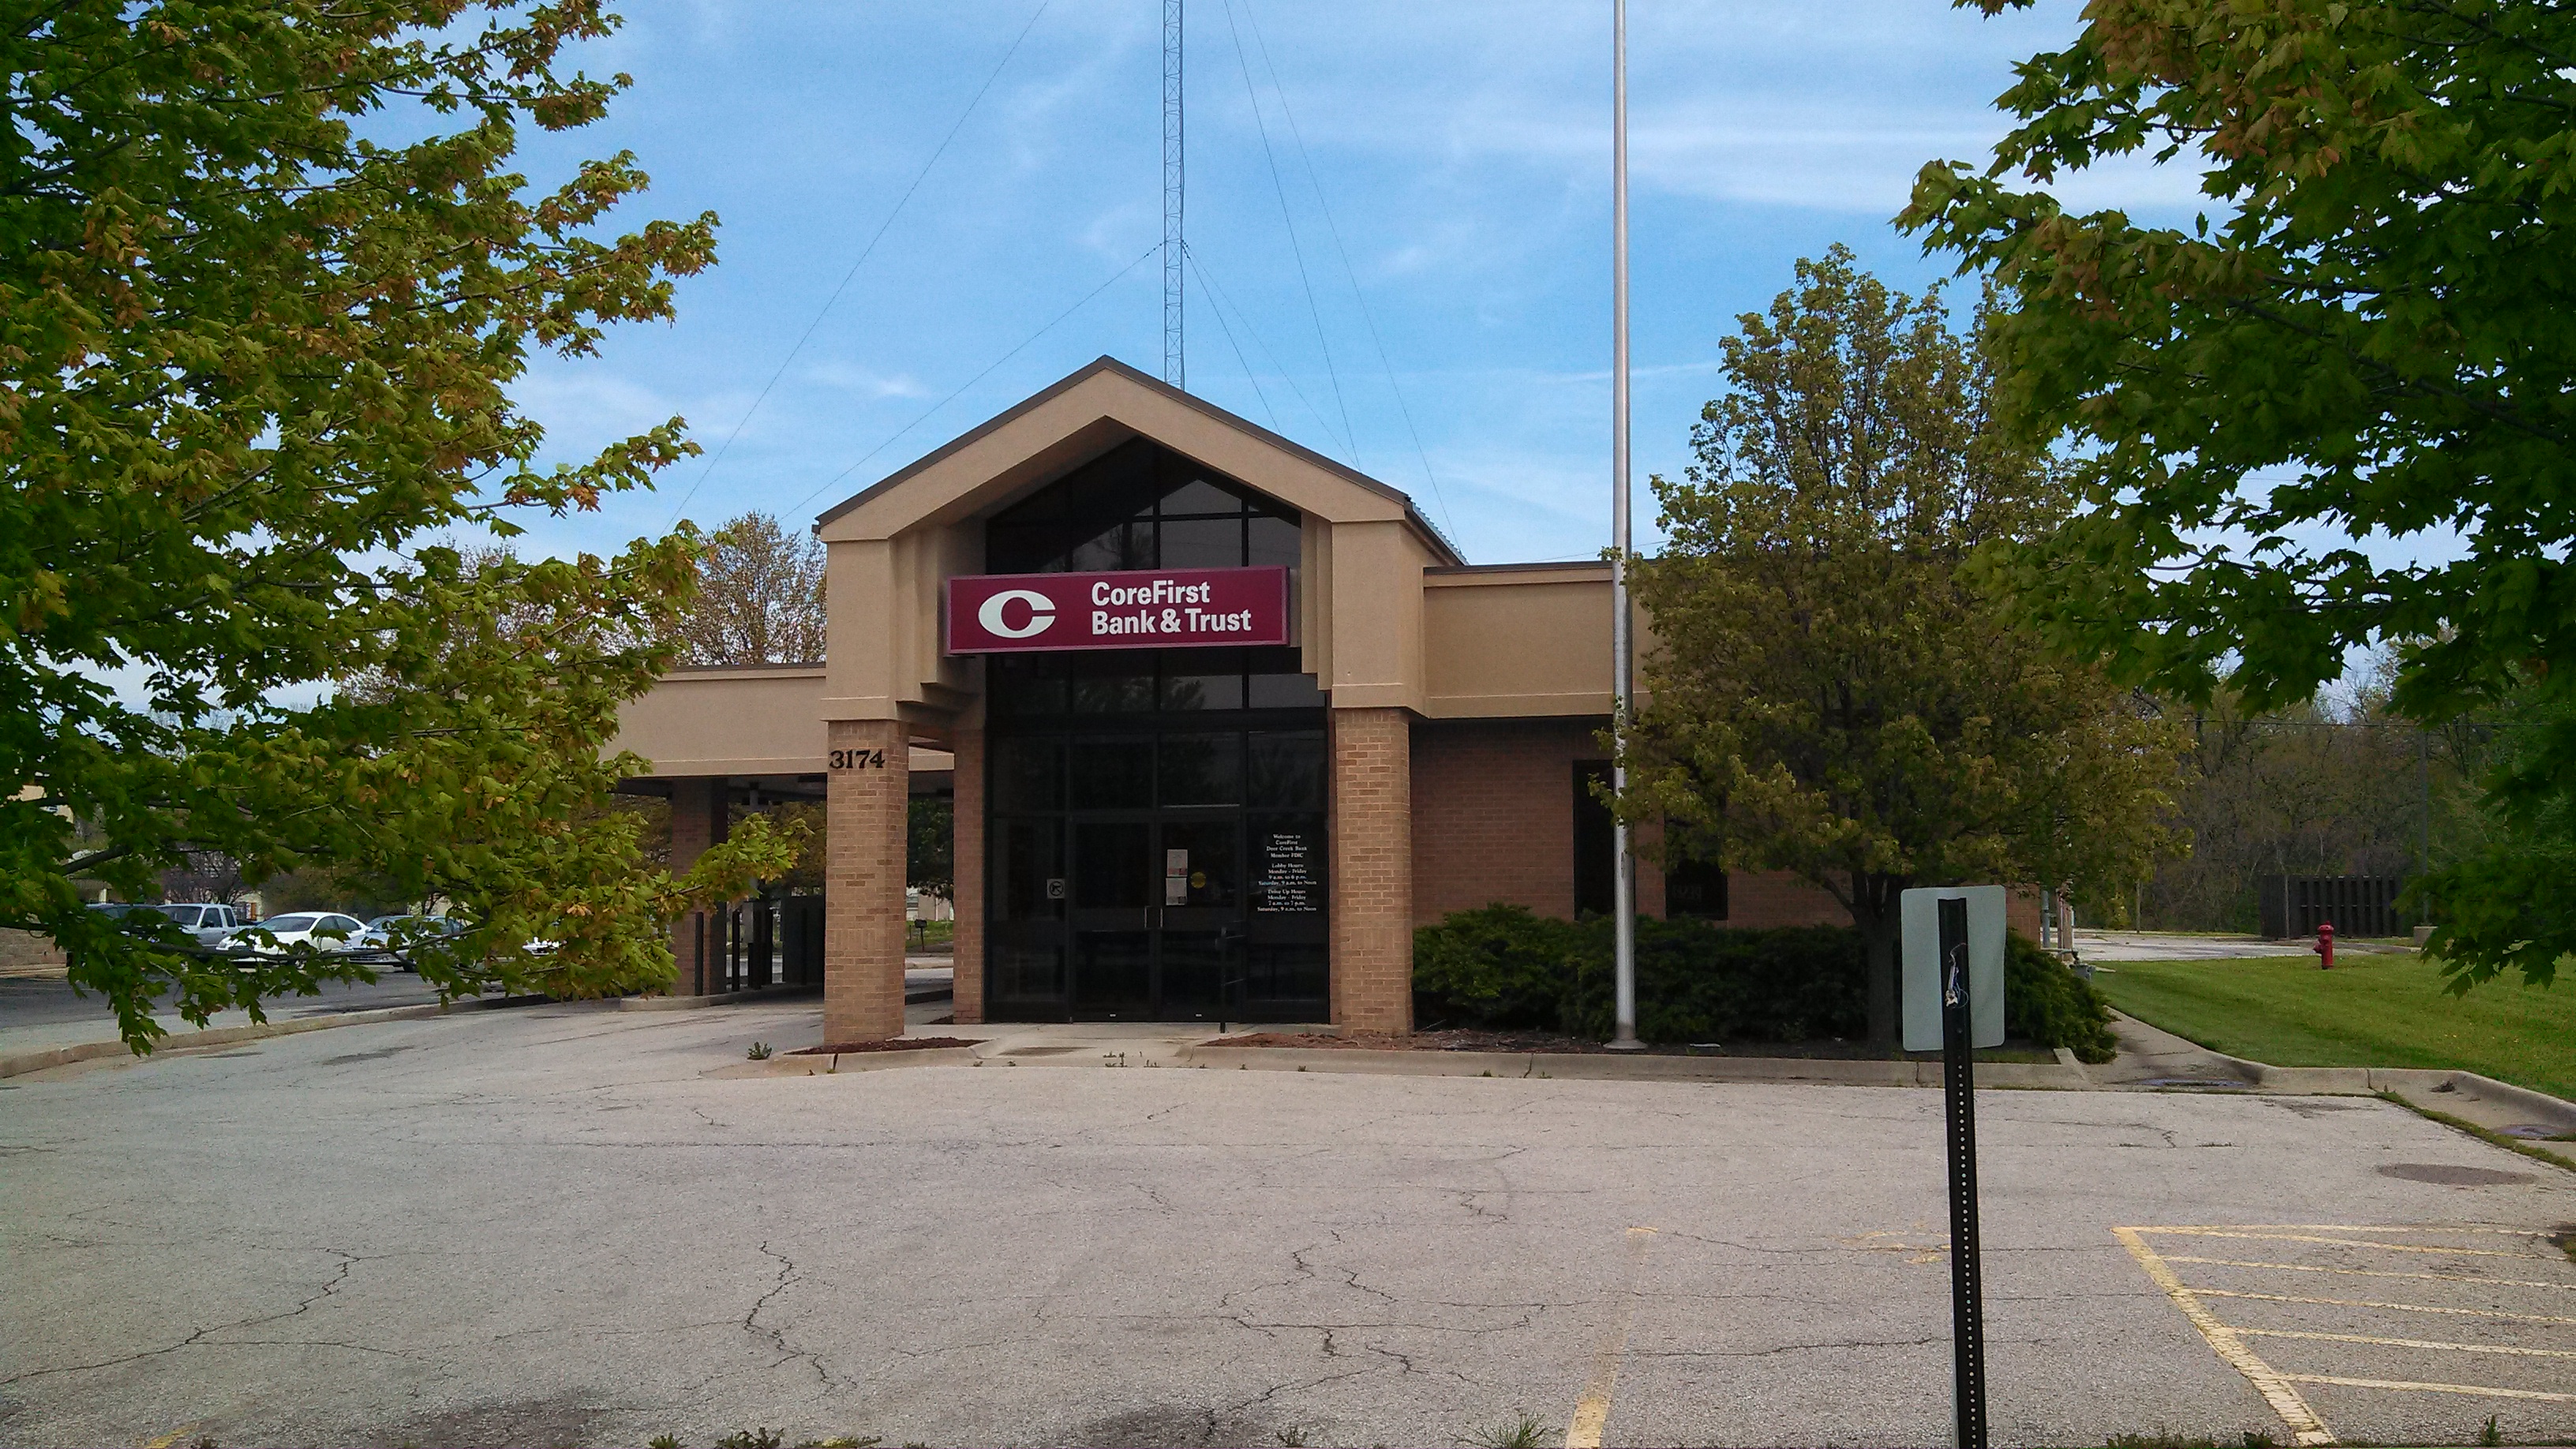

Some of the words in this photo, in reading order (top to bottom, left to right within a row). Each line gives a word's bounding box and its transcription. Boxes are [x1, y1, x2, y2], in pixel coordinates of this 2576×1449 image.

[1091, 580, 1210, 606] CoreFirst
[1091, 610, 1156, 635] Bank
[1160, 608, 1181, 634] &
[1185, 608, 1252, 632] Trust
[829, 749, 886, 769] 3174
